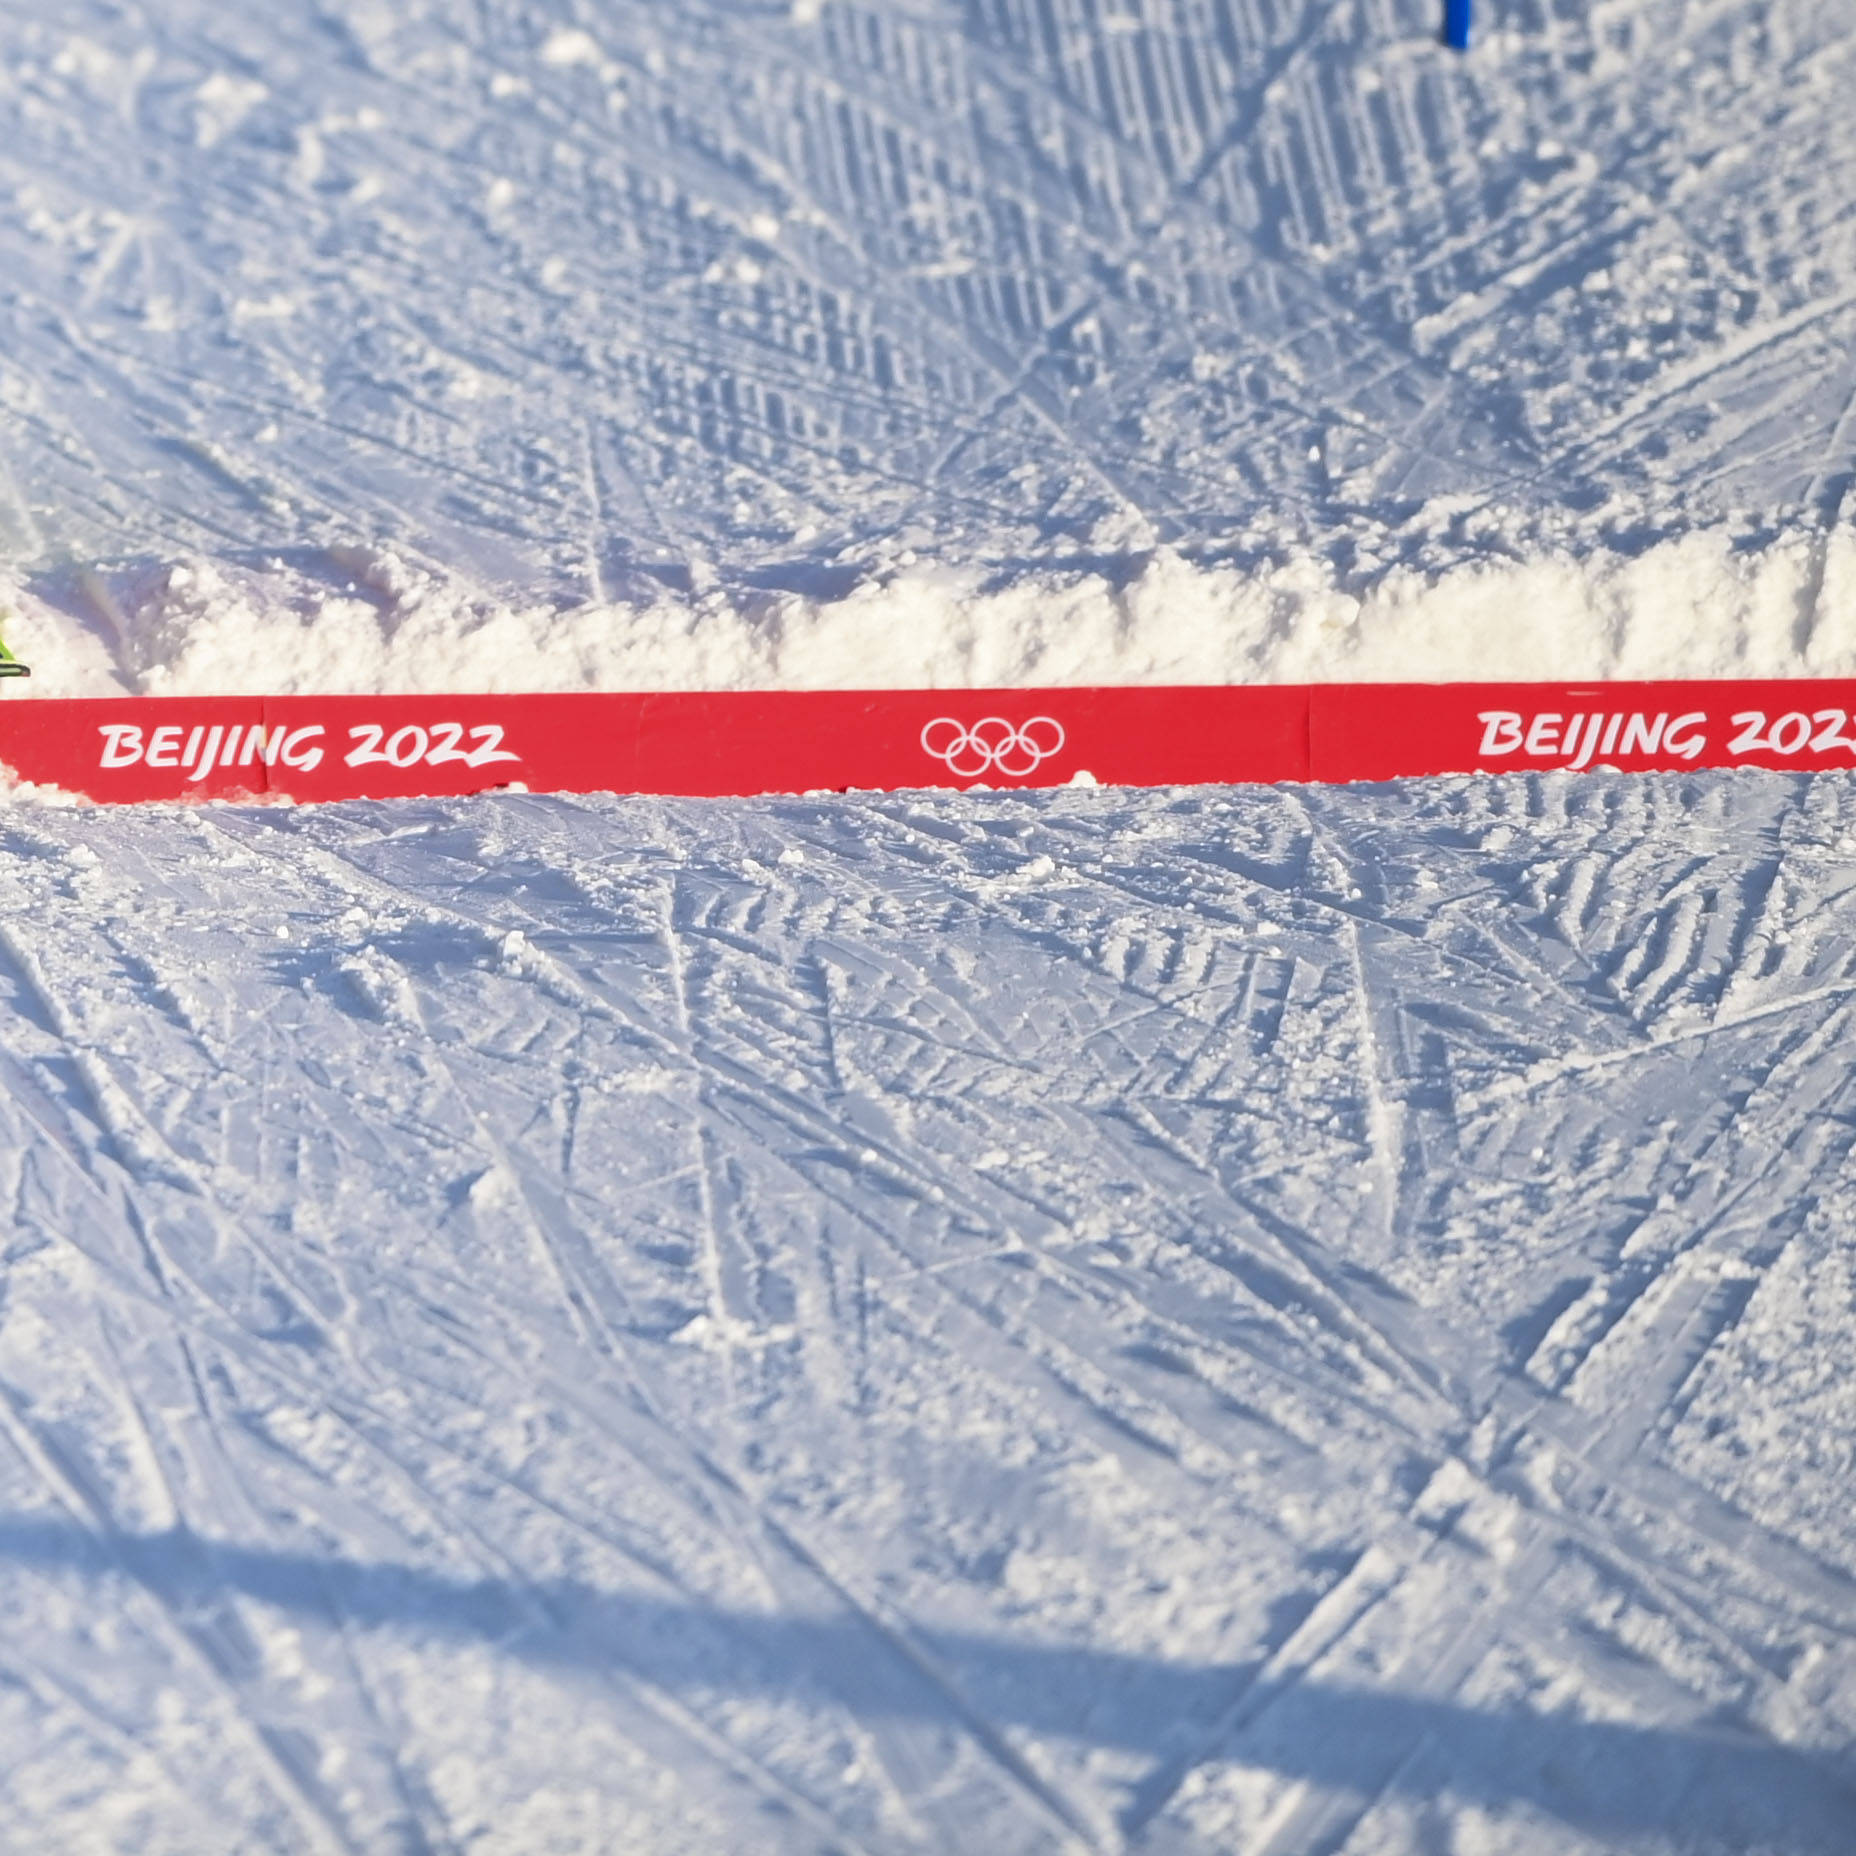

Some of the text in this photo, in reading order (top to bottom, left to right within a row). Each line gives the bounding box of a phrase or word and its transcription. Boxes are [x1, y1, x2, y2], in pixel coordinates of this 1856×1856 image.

[99, 722, 523, 782] BEIJING 2022
[1477, 708, 1856, 769] BEIJING 202
